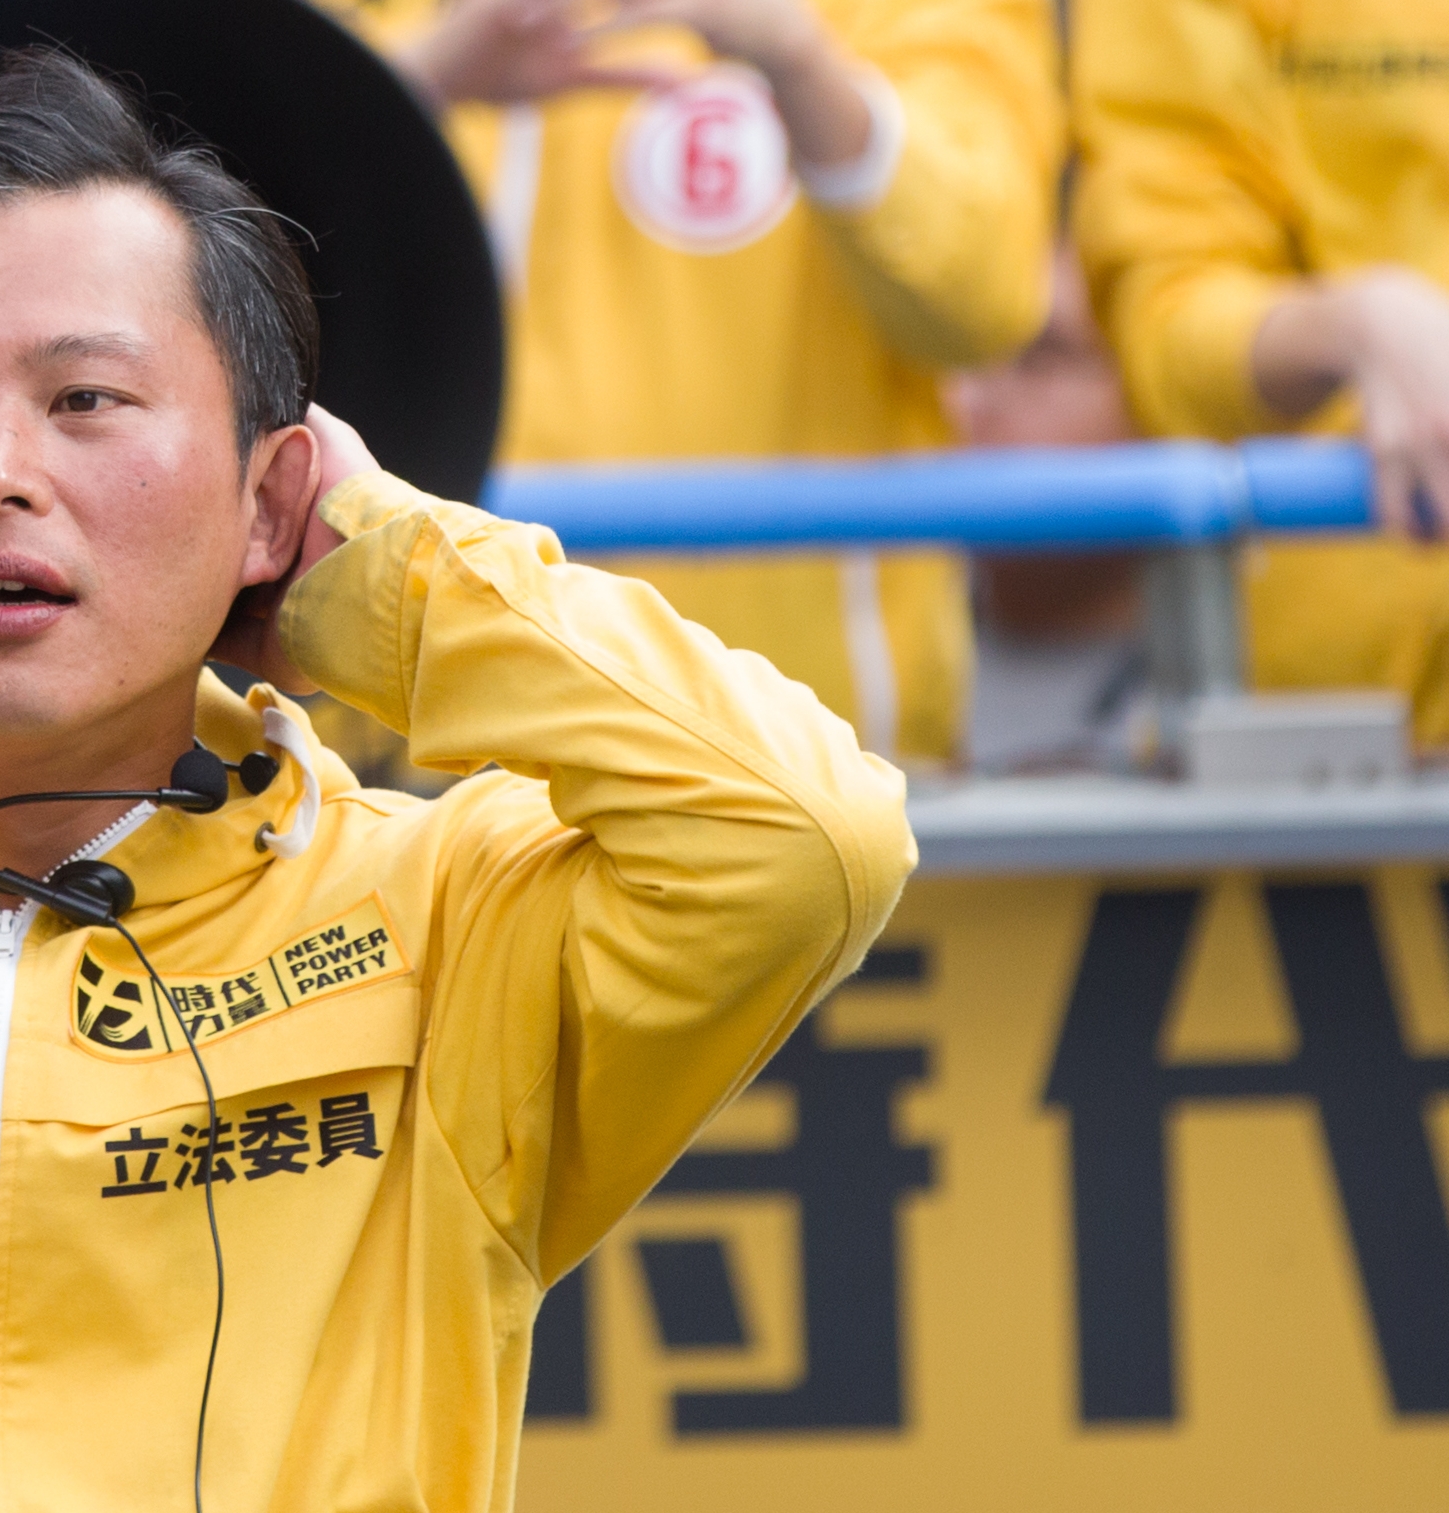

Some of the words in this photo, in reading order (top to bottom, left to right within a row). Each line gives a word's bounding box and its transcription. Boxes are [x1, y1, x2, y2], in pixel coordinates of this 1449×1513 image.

[682, 108, 740, 216] 6
[284, 925, 346, 962] NEW
[289, 928, 389, 978] POWER
[169, 972, 262, 1013] 時代
[296, 950, 386, 995] PARTY
[183, 993, 271, 1040] 力量
[101, 1091, 385, 1198] 立法委員
